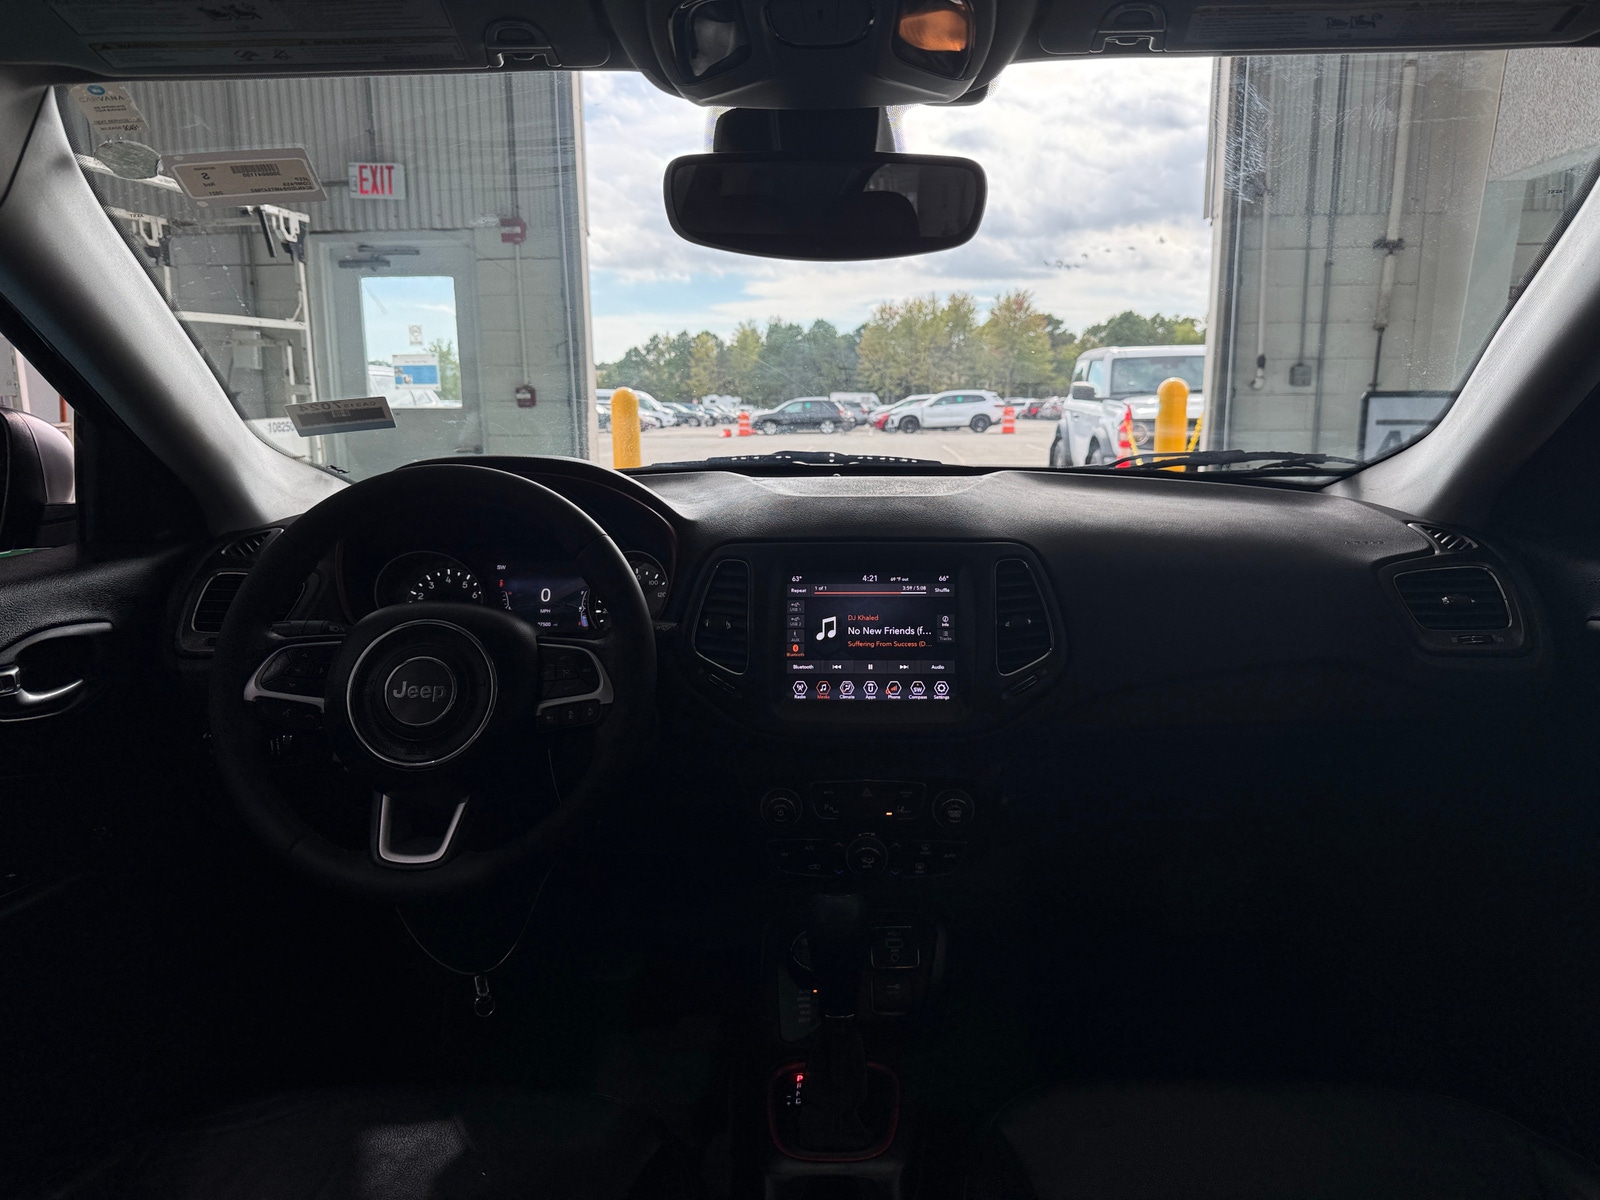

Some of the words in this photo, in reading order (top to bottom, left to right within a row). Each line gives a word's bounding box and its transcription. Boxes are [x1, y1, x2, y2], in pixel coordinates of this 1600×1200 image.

[79, 95, 125, 103] CARVANA
[358, 164, 395, 195] EXIT
[862, 574, 878, 582] 4:21
[428, 581, 435, 589] 3
[462, 581, 468, 589] 5
[417, 592, 424, 600] 2
[471, 591, 478, 599] 6
[541, 588, 551, 602] 0
[848, 626, 860, 635] No
[862, 626, 882, 635] New
[884, 626, 915, 635] Friends
[392, 681, 447, 702] Jeep
[796, 1074, 804, 1082] P
